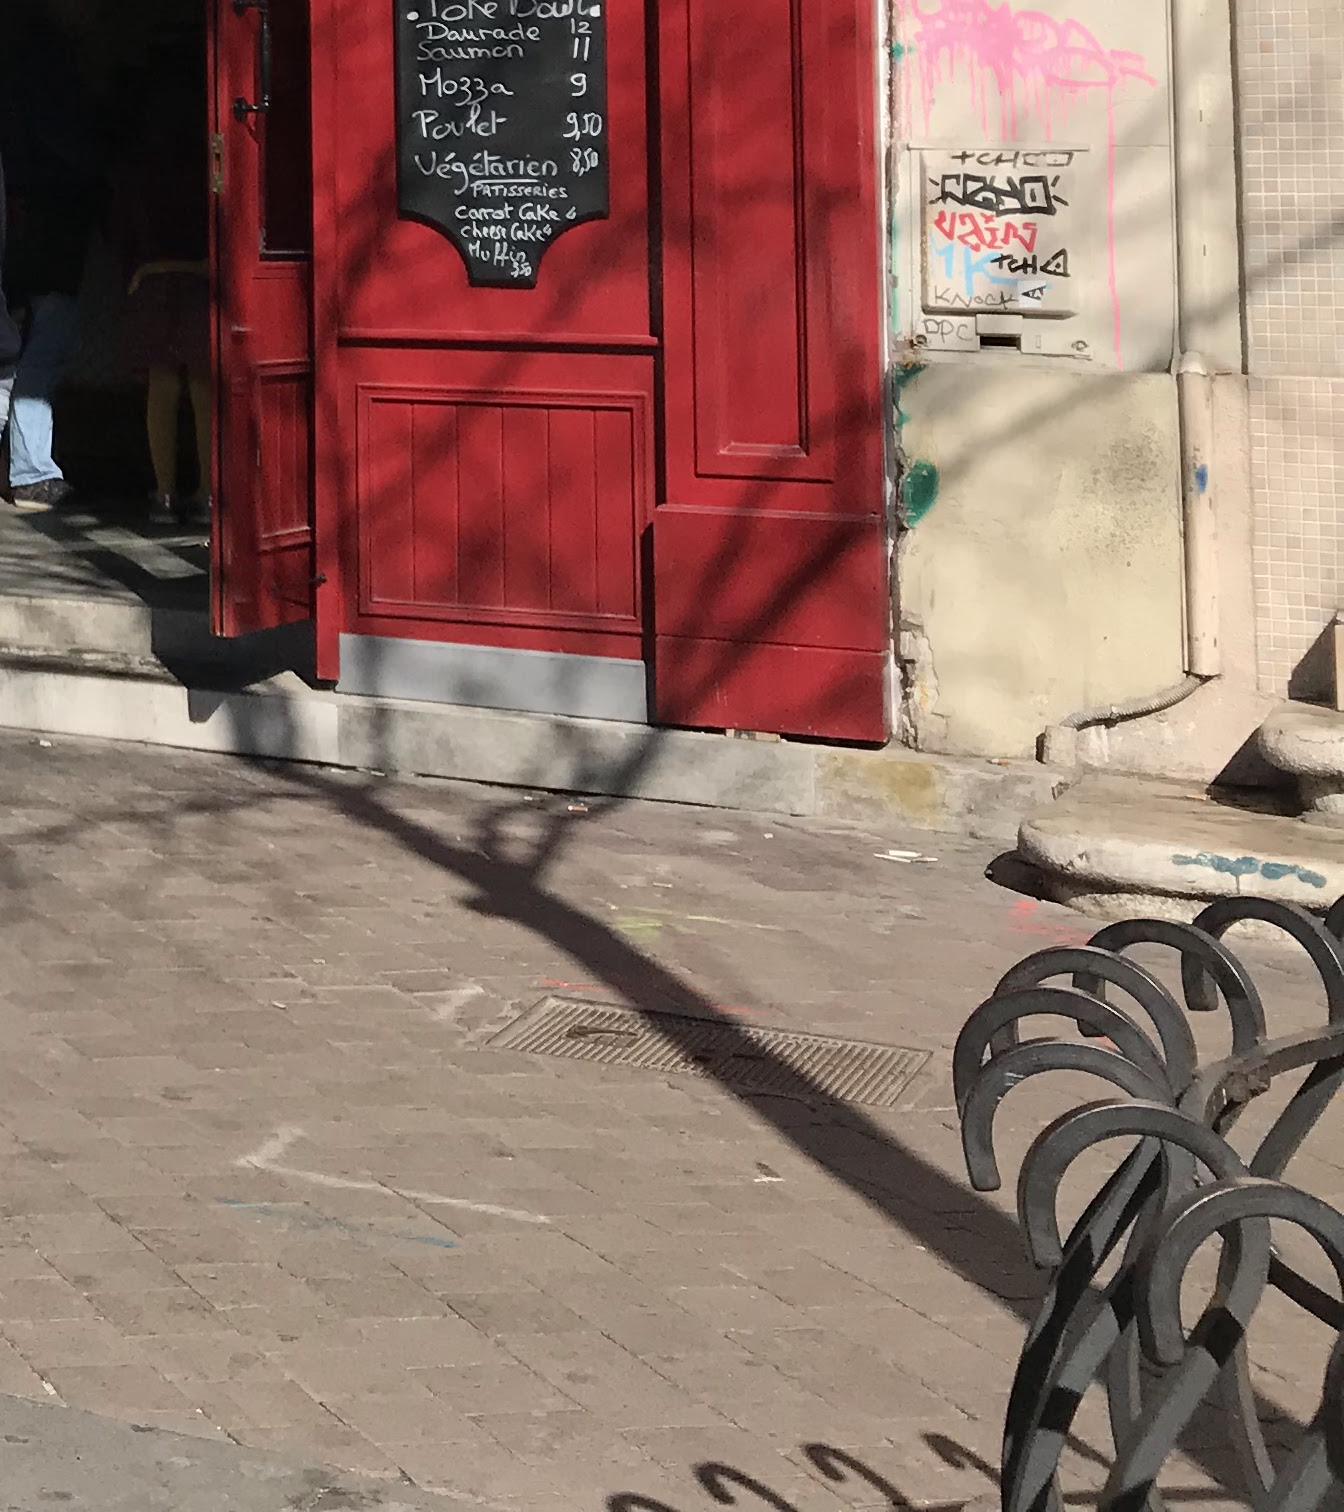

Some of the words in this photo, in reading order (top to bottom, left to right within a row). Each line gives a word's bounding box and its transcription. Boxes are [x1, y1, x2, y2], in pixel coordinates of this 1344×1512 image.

[415, 22, 541, 42] Daurade
[570, 17, 592, 35] 12
[416, 40, 524, 61] Saumon
[418, 66, 514, 107] Mozza
[570, 72, 587, 97] 9
[411, 103, 508, 140] Poulet
[562, 111, 603, 141] 9,50
